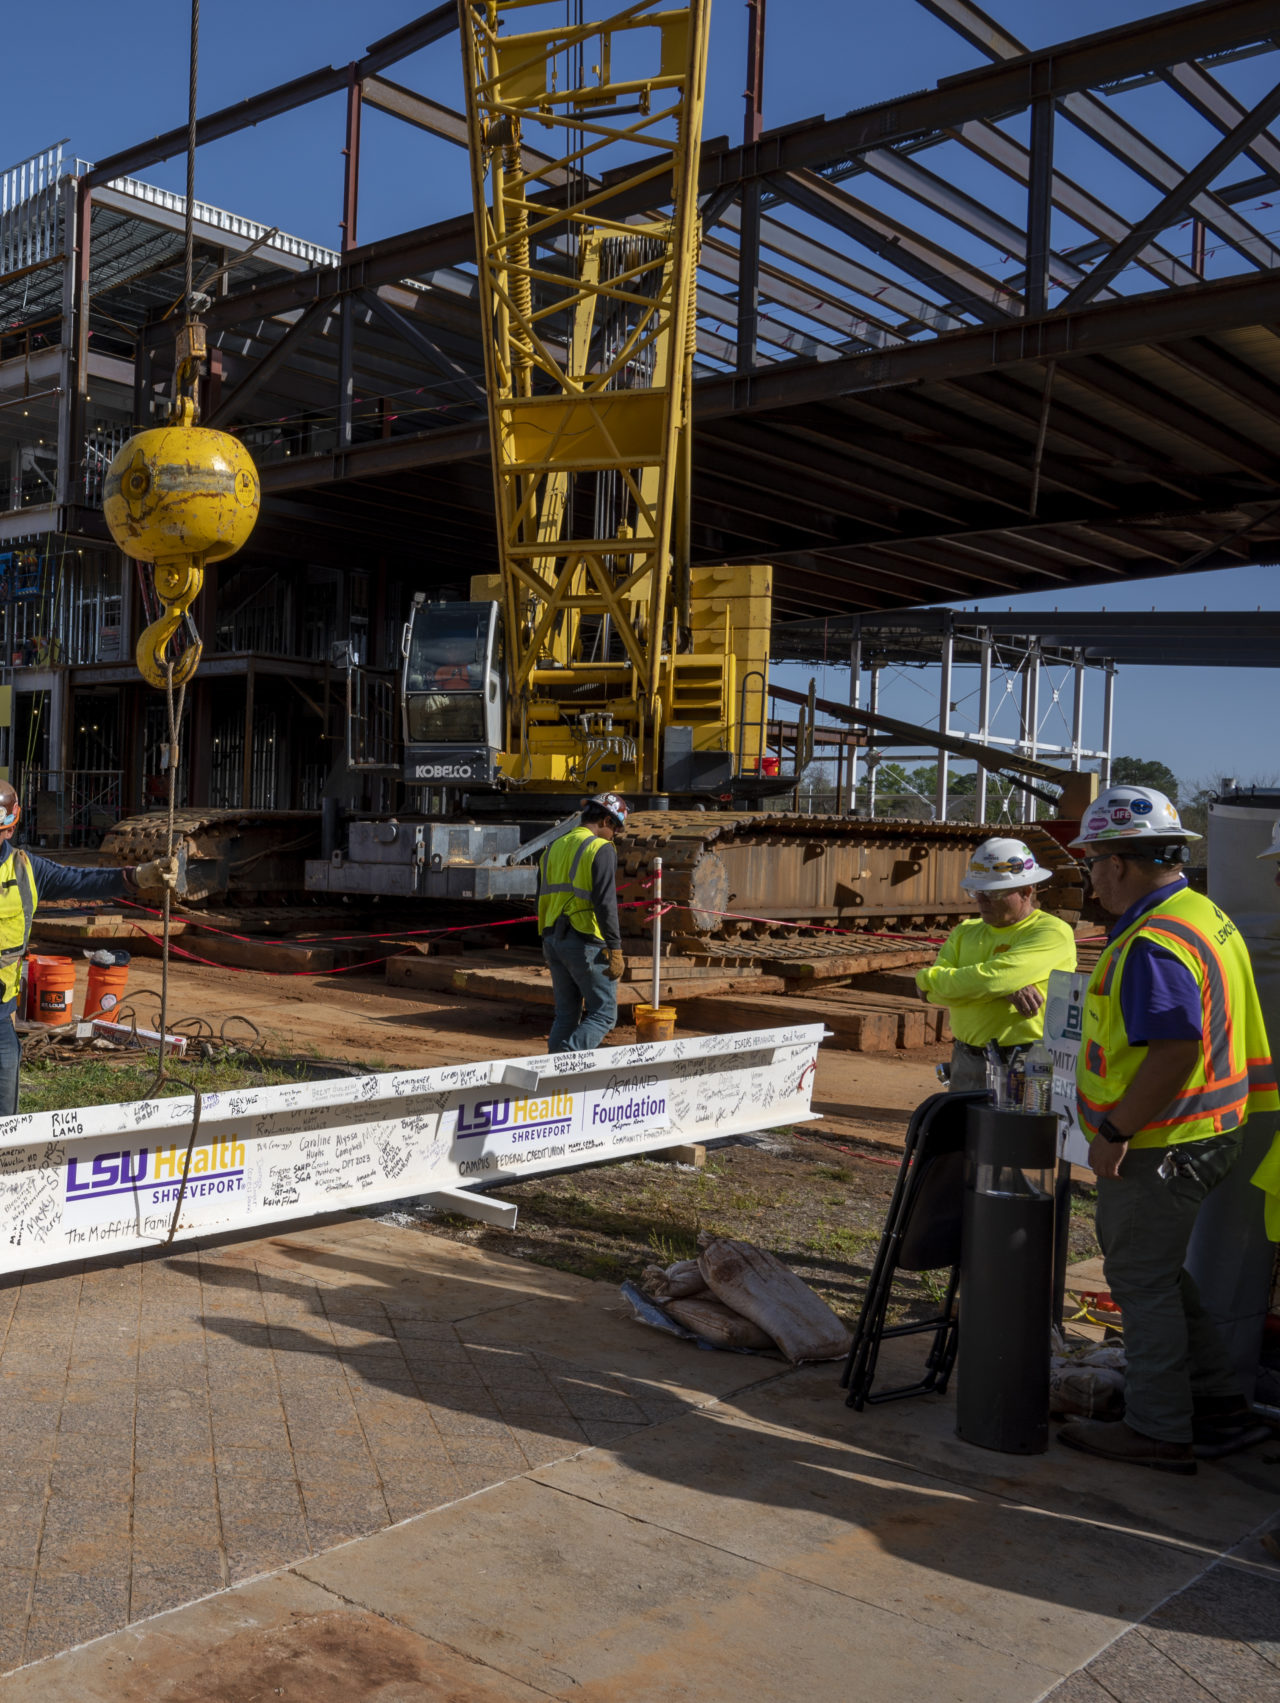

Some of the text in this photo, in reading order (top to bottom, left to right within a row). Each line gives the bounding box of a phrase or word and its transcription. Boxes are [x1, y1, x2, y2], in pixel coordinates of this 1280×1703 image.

[415, 765, 472, 778] KOBELCO
[440, 1070, 459, 1085] Greg
[601, 1074, 659, 1100] ARMAND
[52, 1111, 78, 1127] RICH
[457, 1098, 511, 1132] LSU
[513, 1088, 574, 1123] Health
[592, 1095, 666, 1125] Foundation
[52, 1124, 84, 1138] LAMB
[512, 1123, 571, 1143] SHREVEPORT
[299, 1133, 332, 1152] Caroline
[336, 1141, 363, 1158] Campbell
[66, 1147, 149, 1193] LSU
[154, 1132, 246, 1180] Health
[342, 1158, 355, 1170] DPT
[458, 1143, 566, 1177] CAMPUS FEDERAL CREDIT UNION
[152, 1177, 243, 1205] SHREVEPORT
[65, 1211, 173, 1245] The Moffitt Famil
